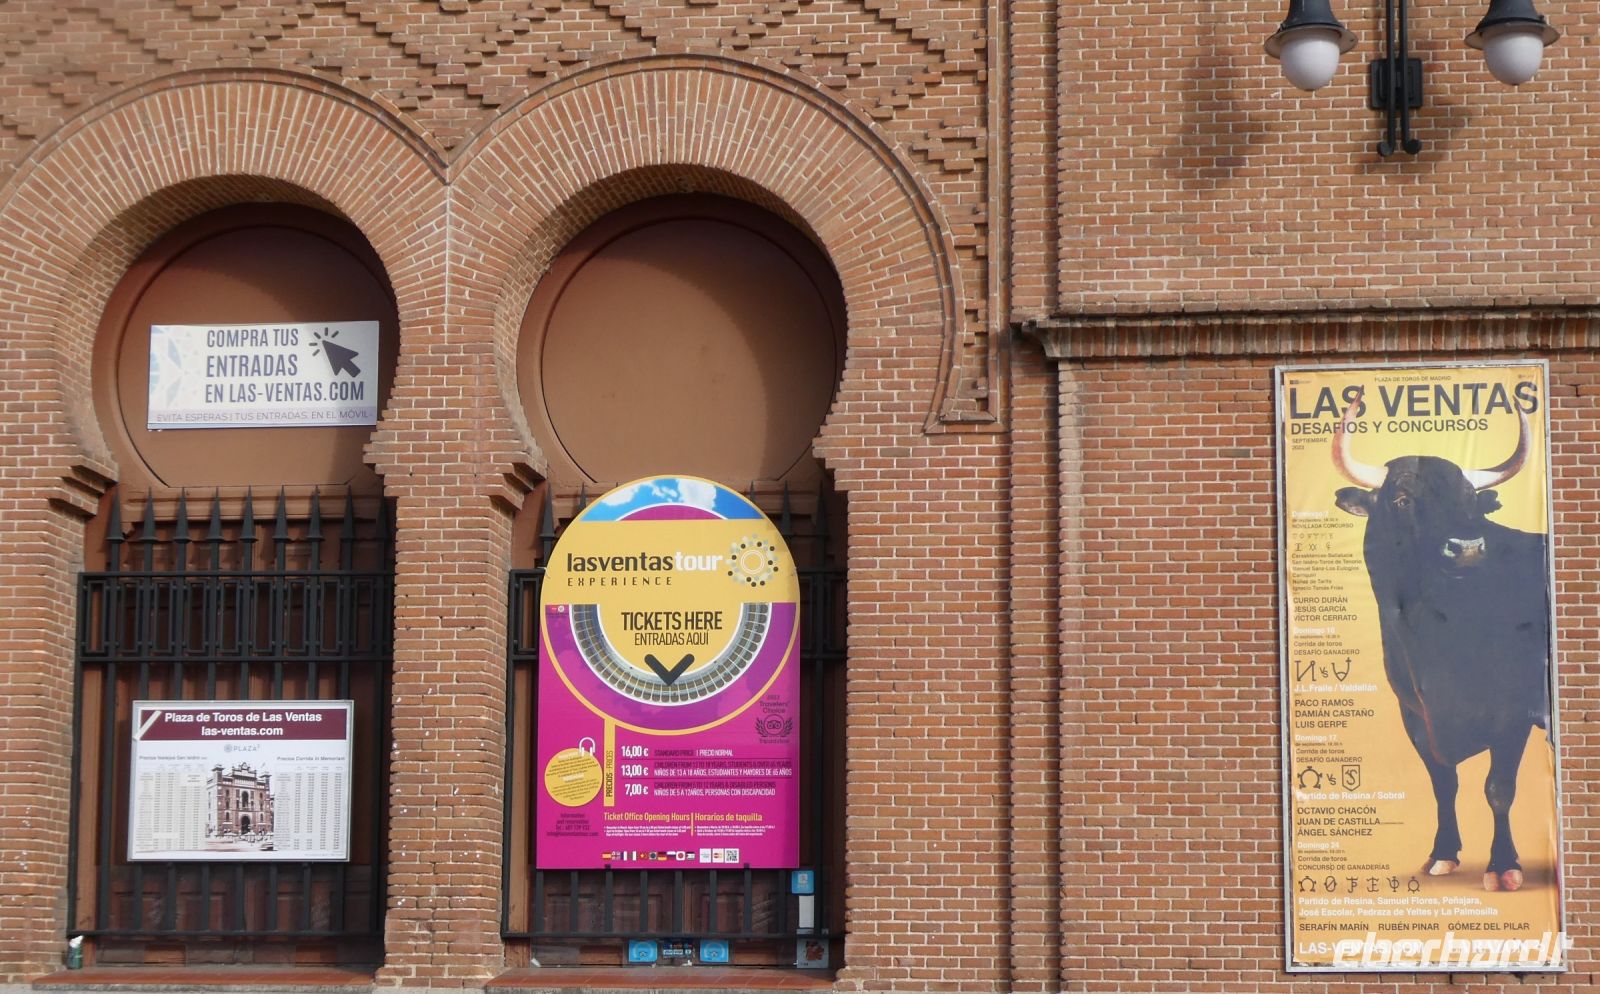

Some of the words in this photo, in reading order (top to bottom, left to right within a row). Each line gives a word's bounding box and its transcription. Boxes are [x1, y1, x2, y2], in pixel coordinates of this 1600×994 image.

[207, 330, 268, 348] COMPRA
[273, 328, 298, 346] TUS
[206, 354, 298, 378] ENTRADAS
[205, 384, 224, 403] EN
[229, 380, 364, 402] LAS-VENTAS.COM
[1290, 384, 1366, 420] LAS
[1378, 381, 1538, 418] VENTAS
[157, 413, 182, 422] EVITA
[236, 412, 254, 421] TUS
[312, 411, 323, 419] EN
[1373, 421, 1382, 433] Y
[1388, 418, 1488, 433] CONCURSOS
[567, 552, 723, 572] lasventastour
[568, 576, 673, 586] EXPERIENCE
[621, 612, 682, 630] TICKETS
[685, 611, 722, 630] HERE
[634, 632, 685, 646] ENTRADAS
[686, 629, 709, 645] AQUÍ
[165, 712, 194, 722] Plaza
[196, 712, 210, 722] de
[212, 712, 243, 722] Toros
[245, 712, 260, 722] de
[262, 712, 282, 722] Las
[285, 712, 322, 722] Ventas
[1294, 708, 1330, 718] DAMIÁN
[1332, 708, 1374, 718] CASTAÑO
[1318, 720, 1348, 728] GERPE
[201, 726, 284, 736] las-ventas.com
[621, 746, 642, 758] 16,00
[643, 748, 648, 756] €
[621, 764, 642, 778] 13,00
[643, 768, 648, 776] €
[625, 784, 642, 796] 7,00
[643, 786, 648, 794] €
[1378, 792, 1406, 800] Sobral
[1338, 805, 1376, 814] CHACÓN
[604, 812, 623, 820] Ticket
[624, 812, 643, 820] Office
[644, 812, 670, 822] Opening
[672, 812, 690, 820] Hours
[694, 812, 724, 820] Horarios
[726, 812, 734, 820] de
[736, 812, 762, 822] taquilla
[1298, 818, 1321, 826] JUAN
[1324, 818, 1336, 826] DE
[1338, 818, 1380, 826] CASTILLA
[1298, 828, 1328, 836] ÁNGEL
[1330, 827, 1373, 836] SÁNCHEZ
[1298, 896, 1328, 905] Partido
[1331, 896, 1342, 905] de
[1377, 896, 1410, 905] Samuel
[1298, 908, 1320, 916] José
[1357, 908, 1392, 916] Pedraza
[1394, 908, 1404, 916] de
[1407, 908, 1432, 916] Yeltes
[1441, 908, 1452, 916] La
[1454, 907, 1498, 916] Palmosilla
[1299, 921, 1338, 931] SERAFÍN
[1340, 921, 1369, 930] MARÍN
[1378, 921, 1410, 930] RUBÉN
[1412, 922, 1440, 930] PINAR
[1448, 921, 1481, 930] GÓMEZ
[1484, 922, 1501, 930] DEL
[1504, 922, 1530, 930] PILAR
